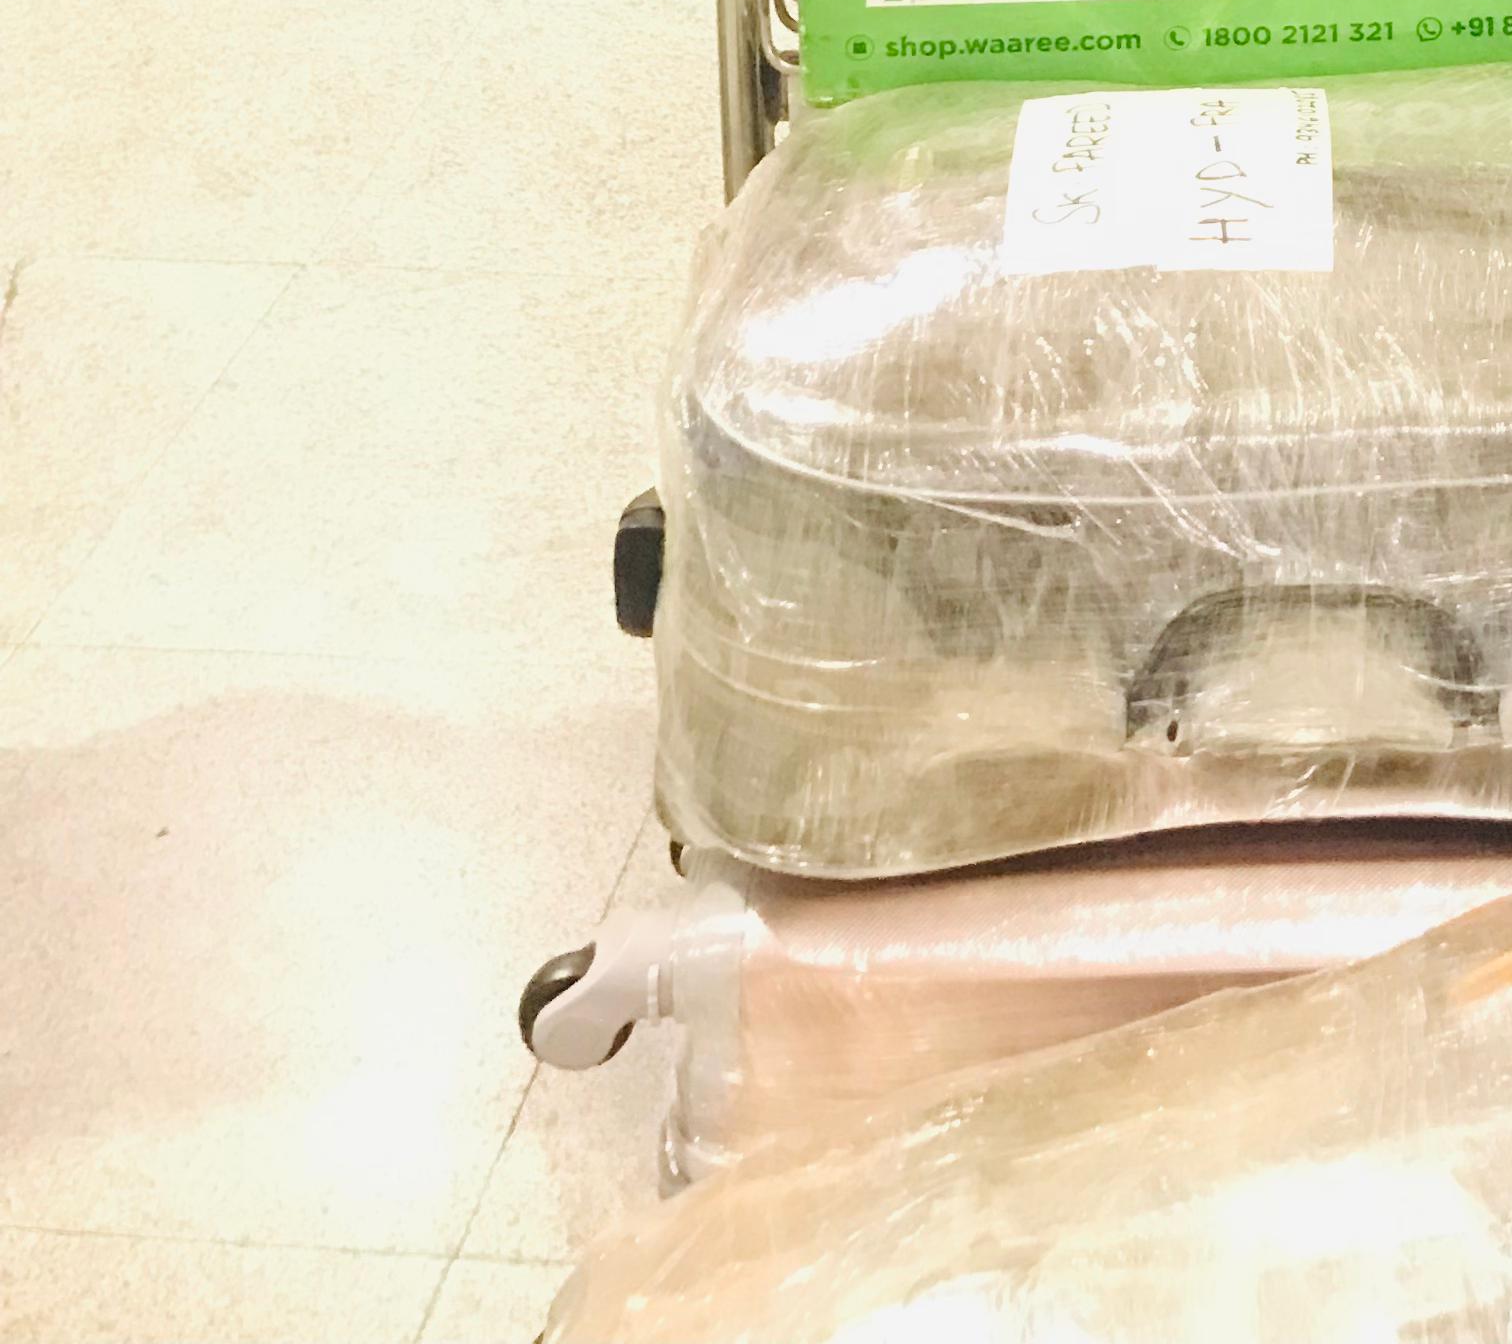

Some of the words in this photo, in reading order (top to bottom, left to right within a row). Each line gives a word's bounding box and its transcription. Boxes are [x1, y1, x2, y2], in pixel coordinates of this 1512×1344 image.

[886, 29, 1141, 60] shop.waaree.com
[1204, 25, 1271, 47] 1800
[1282, 23, 1338, 45] 2121
[1349, 21, 1393, 43] 321
[1451, 15, 1494, 38] +91
